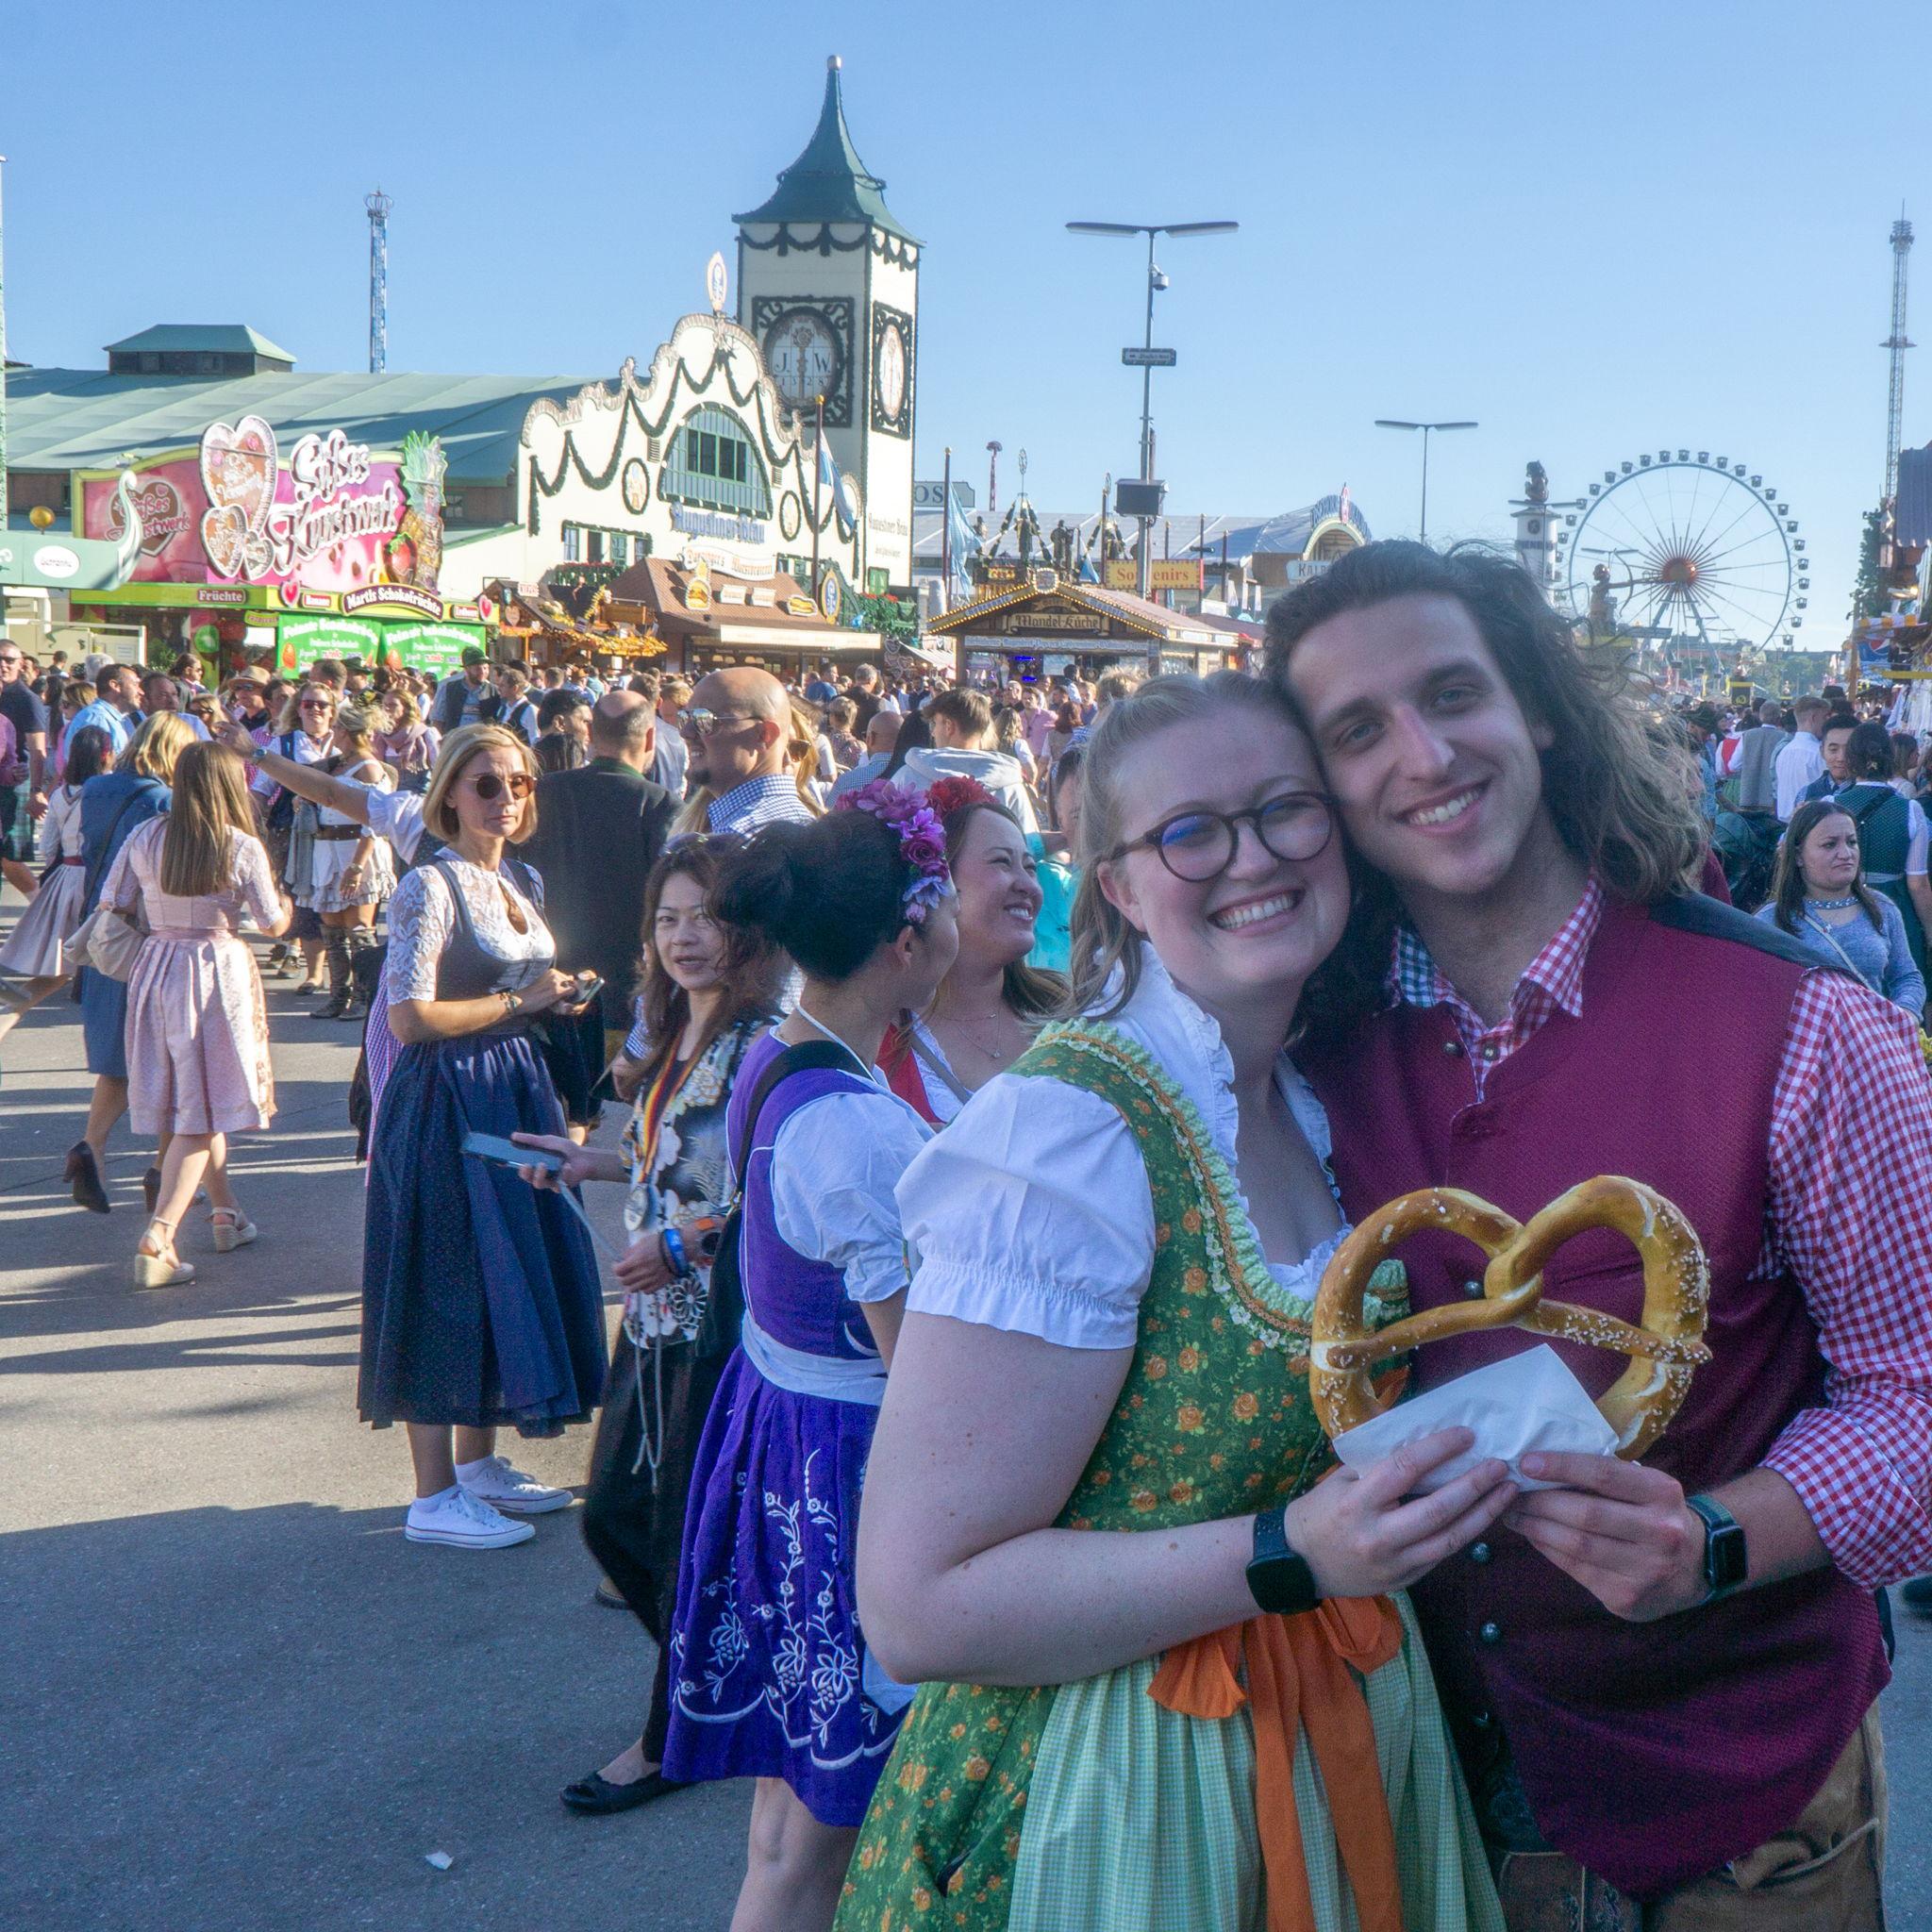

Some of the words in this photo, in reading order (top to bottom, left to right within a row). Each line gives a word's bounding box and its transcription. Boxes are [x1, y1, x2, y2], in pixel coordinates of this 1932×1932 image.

[1116, 568, 1189, 581] Soenirs
[198, 589, 242, 602] Früchte
[377, 587, 441, 615] Schokofrüchte
[1016, 614, 1098, 630] Mandel-Küche
